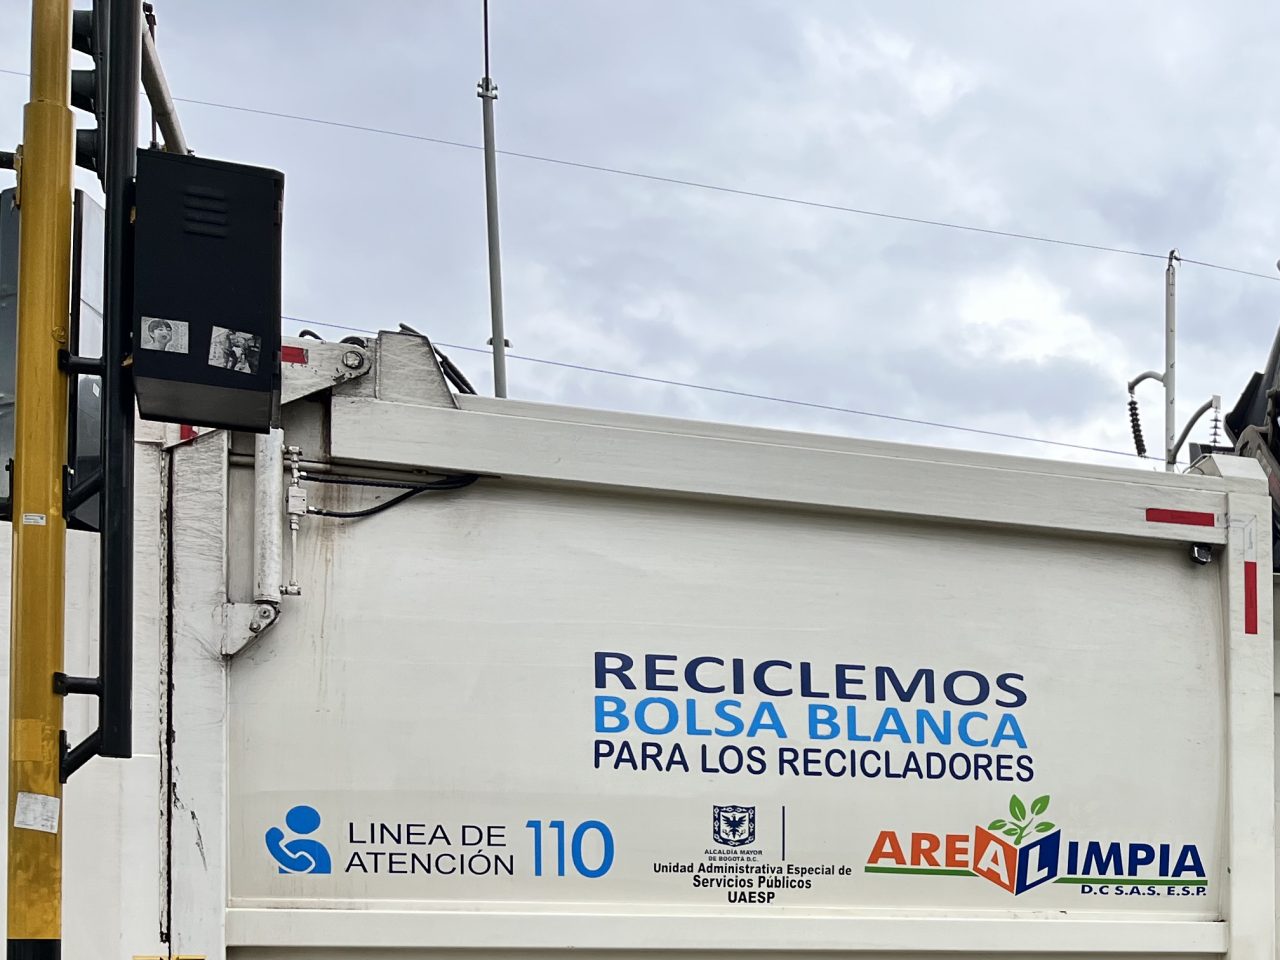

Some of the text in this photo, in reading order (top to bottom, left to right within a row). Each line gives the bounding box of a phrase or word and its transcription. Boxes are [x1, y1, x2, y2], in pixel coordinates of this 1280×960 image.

[594, 651, 1027, 708] RECICLEMOS
[594, 695, 1028, 749] BOLSA BLANCA
[593, 740, 1035, 783] PARA LOS RECICLADORES
[349, 822, 507, 847] LINEA DE
[525, 819, 615, 879] 110
[345, 849, 514, 876] ATENCIÓN
[653, 862, 852, 877] Unidad Administrativa Especial de
[692, 874, 812, 889] Servicios Públicos
[1115, 885, 1161, 896] S.A.S.
[1167, 886, 1207, 897] E.S.P.
[727, 891, 776, 904] UAESP
